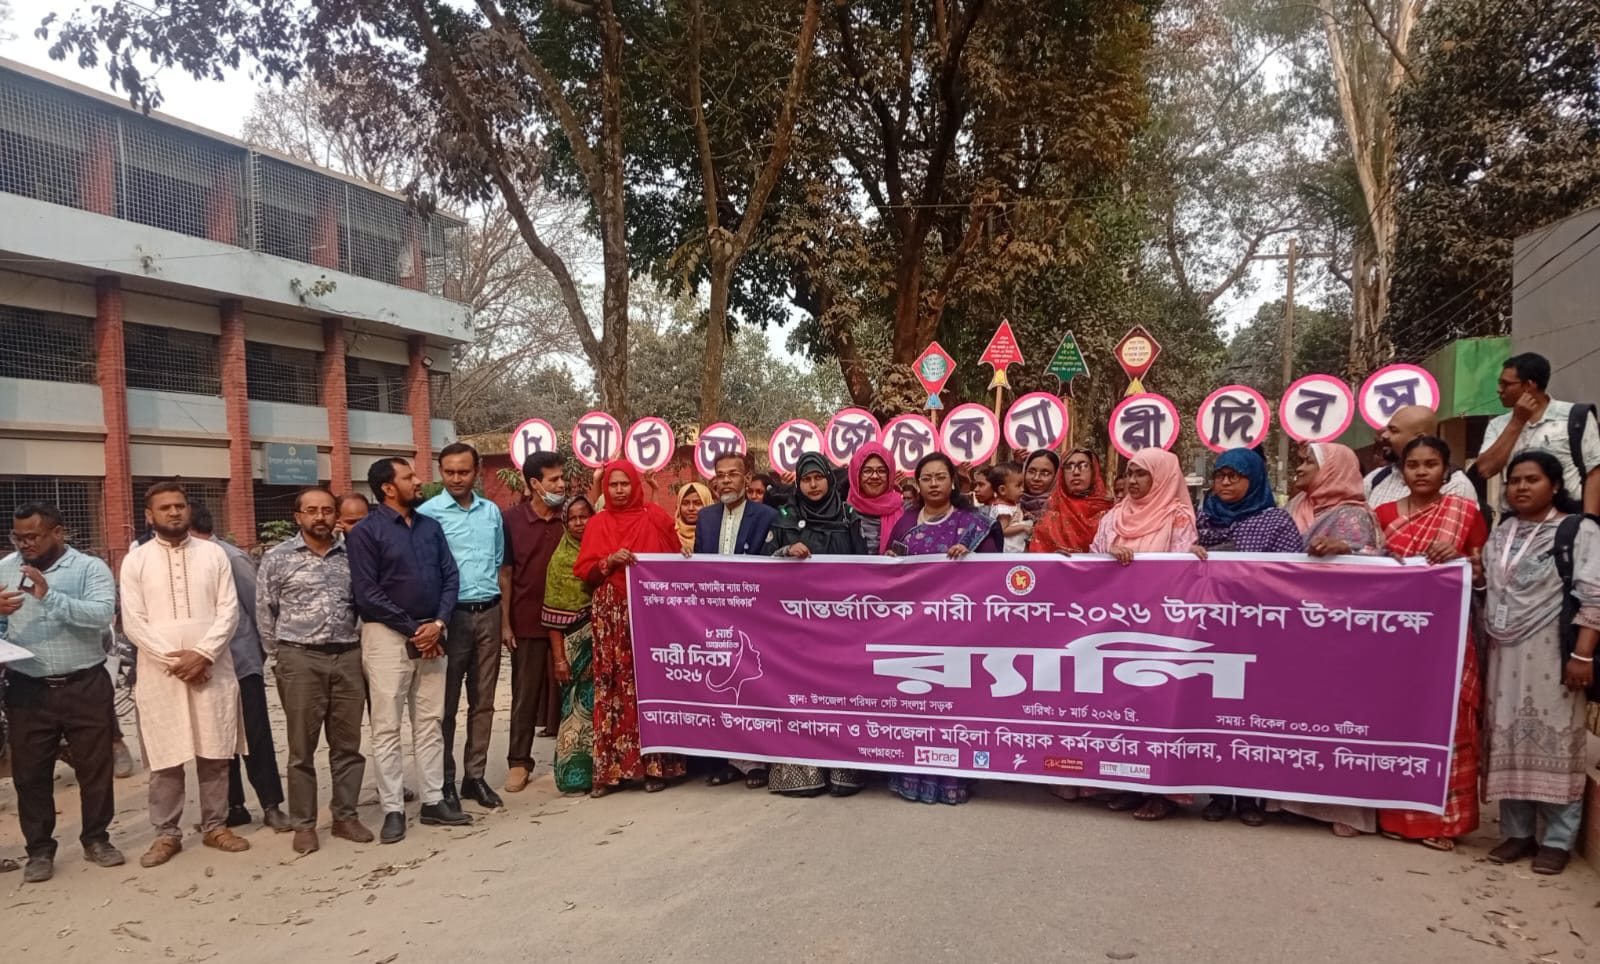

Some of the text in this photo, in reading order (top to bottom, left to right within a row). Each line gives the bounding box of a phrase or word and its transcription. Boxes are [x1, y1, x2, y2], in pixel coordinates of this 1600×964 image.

[1210, 394, 1257, 444] দি
[1295, 388, 1337, 433] ব
[1010, 399, 1057, 448] না
[950, 417, 985, 460] ক
[684, 594, 697, 605] নারী
[780, 594, 915, 620] আন্তর্জাতিক
[922, 594, 976, 621] নারী
[1298, 599, 1433, 633] উপলক্ষে
[716, 626, 733, 638] মার্চ
[650, 643, 733, 667] নারী দিবস
[666, 667, 702, 682] ২০২৬
[788, 693, 953, 712] স্থান: উপজেলা পরিষদ গেট সংলগ্ন সড়ক
[1023, 703, 1054, 715] তারিখ:
[1070, 705, 1088, 717] মার্চ
[1092, 709, 1121, 720] ২০২৬
[1215, 714, 1368, 737] সময়: বিকেল ০৩.০০ ঘটিকা
[643, 711, 715, 727] আয়োজনে:
[720, 714, 782, 732] উপজেলা
[788, 720, 842, 737] প্রশাসন
[848, 725, 860, 736] ও
[866, 719, 936, 743] উপজেলা
[940, 724, 990, 746] মহিলা
[995, 727, 1054, 748] বিষয়ক
[1060, 731, 1140, 755] কর্মকর্তার
[1145, 737, 1222, 762] কার্যালয়,
[1230, 738, 1324, 770] বিরামপুর,
[1333, 746, 1430, 777] দিনাজপুর
[858, 747, 904, 758] অংশগ্রহণে:
[931, 750, 957, 763] brac
